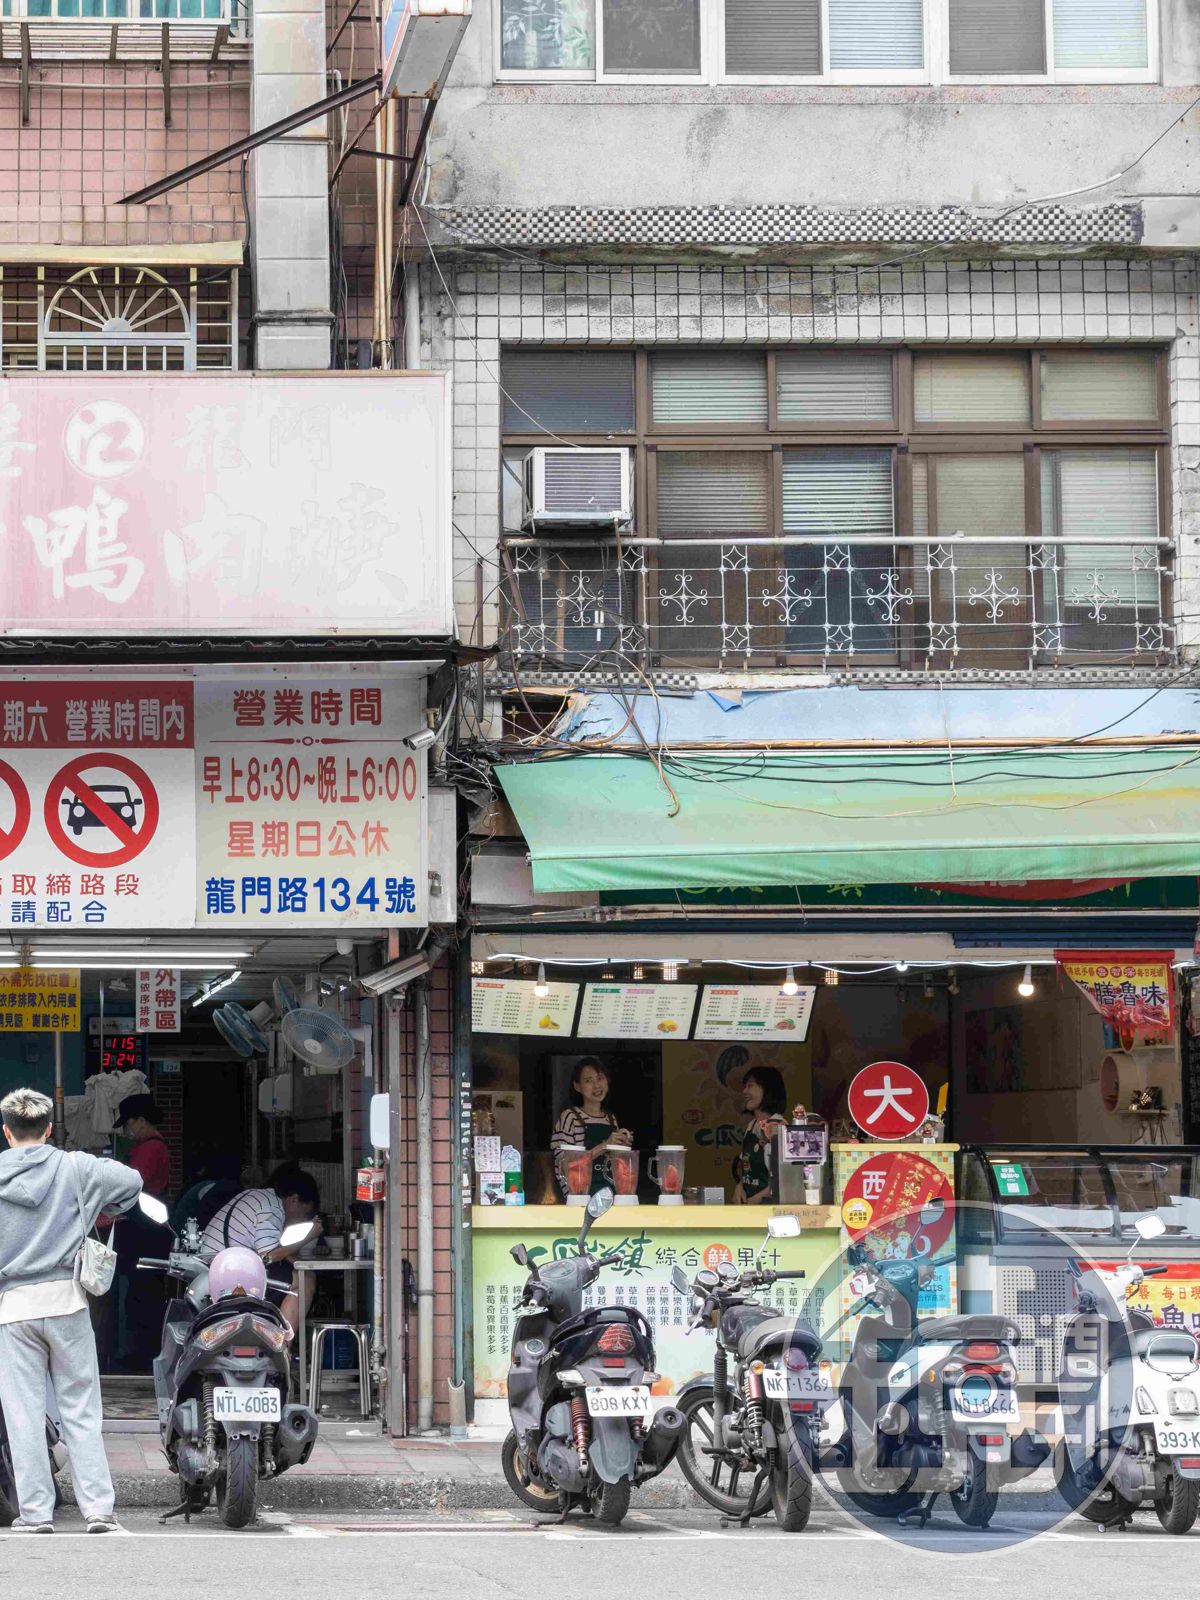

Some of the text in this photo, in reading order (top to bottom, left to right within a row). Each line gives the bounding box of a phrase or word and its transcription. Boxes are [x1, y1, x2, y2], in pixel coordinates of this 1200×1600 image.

[65, 699, 186, 742] 營業時間內
[233, 688, 382, 727] 營業時間
[202, 755, 418, 804] 早上8:30~晚上6:00
[227, 820, 390, 857] 星期日公休
[205, 876, 417, 914] 龍門路134號
[155, 967, 177, 1030] 外帶區
[864, 1075, 916, 1124] 大
[862, 1171, 887, 1200] 西
[655, 1246, 782, 1268] 綜合鮮果汁
[485, 1285, 496, 1355] 草莓奇異果多多
[499, 1285, 510, 1355] 香蕉百香果多多
[659, 1286, 670, 1326] 芭樂蘋果
[815, 1287, 825, 1327] 西瓜牛奶
[216, 1396, 278, 1413] NTL-6083
[589, 1397, 649, 1411] 808-KXY
